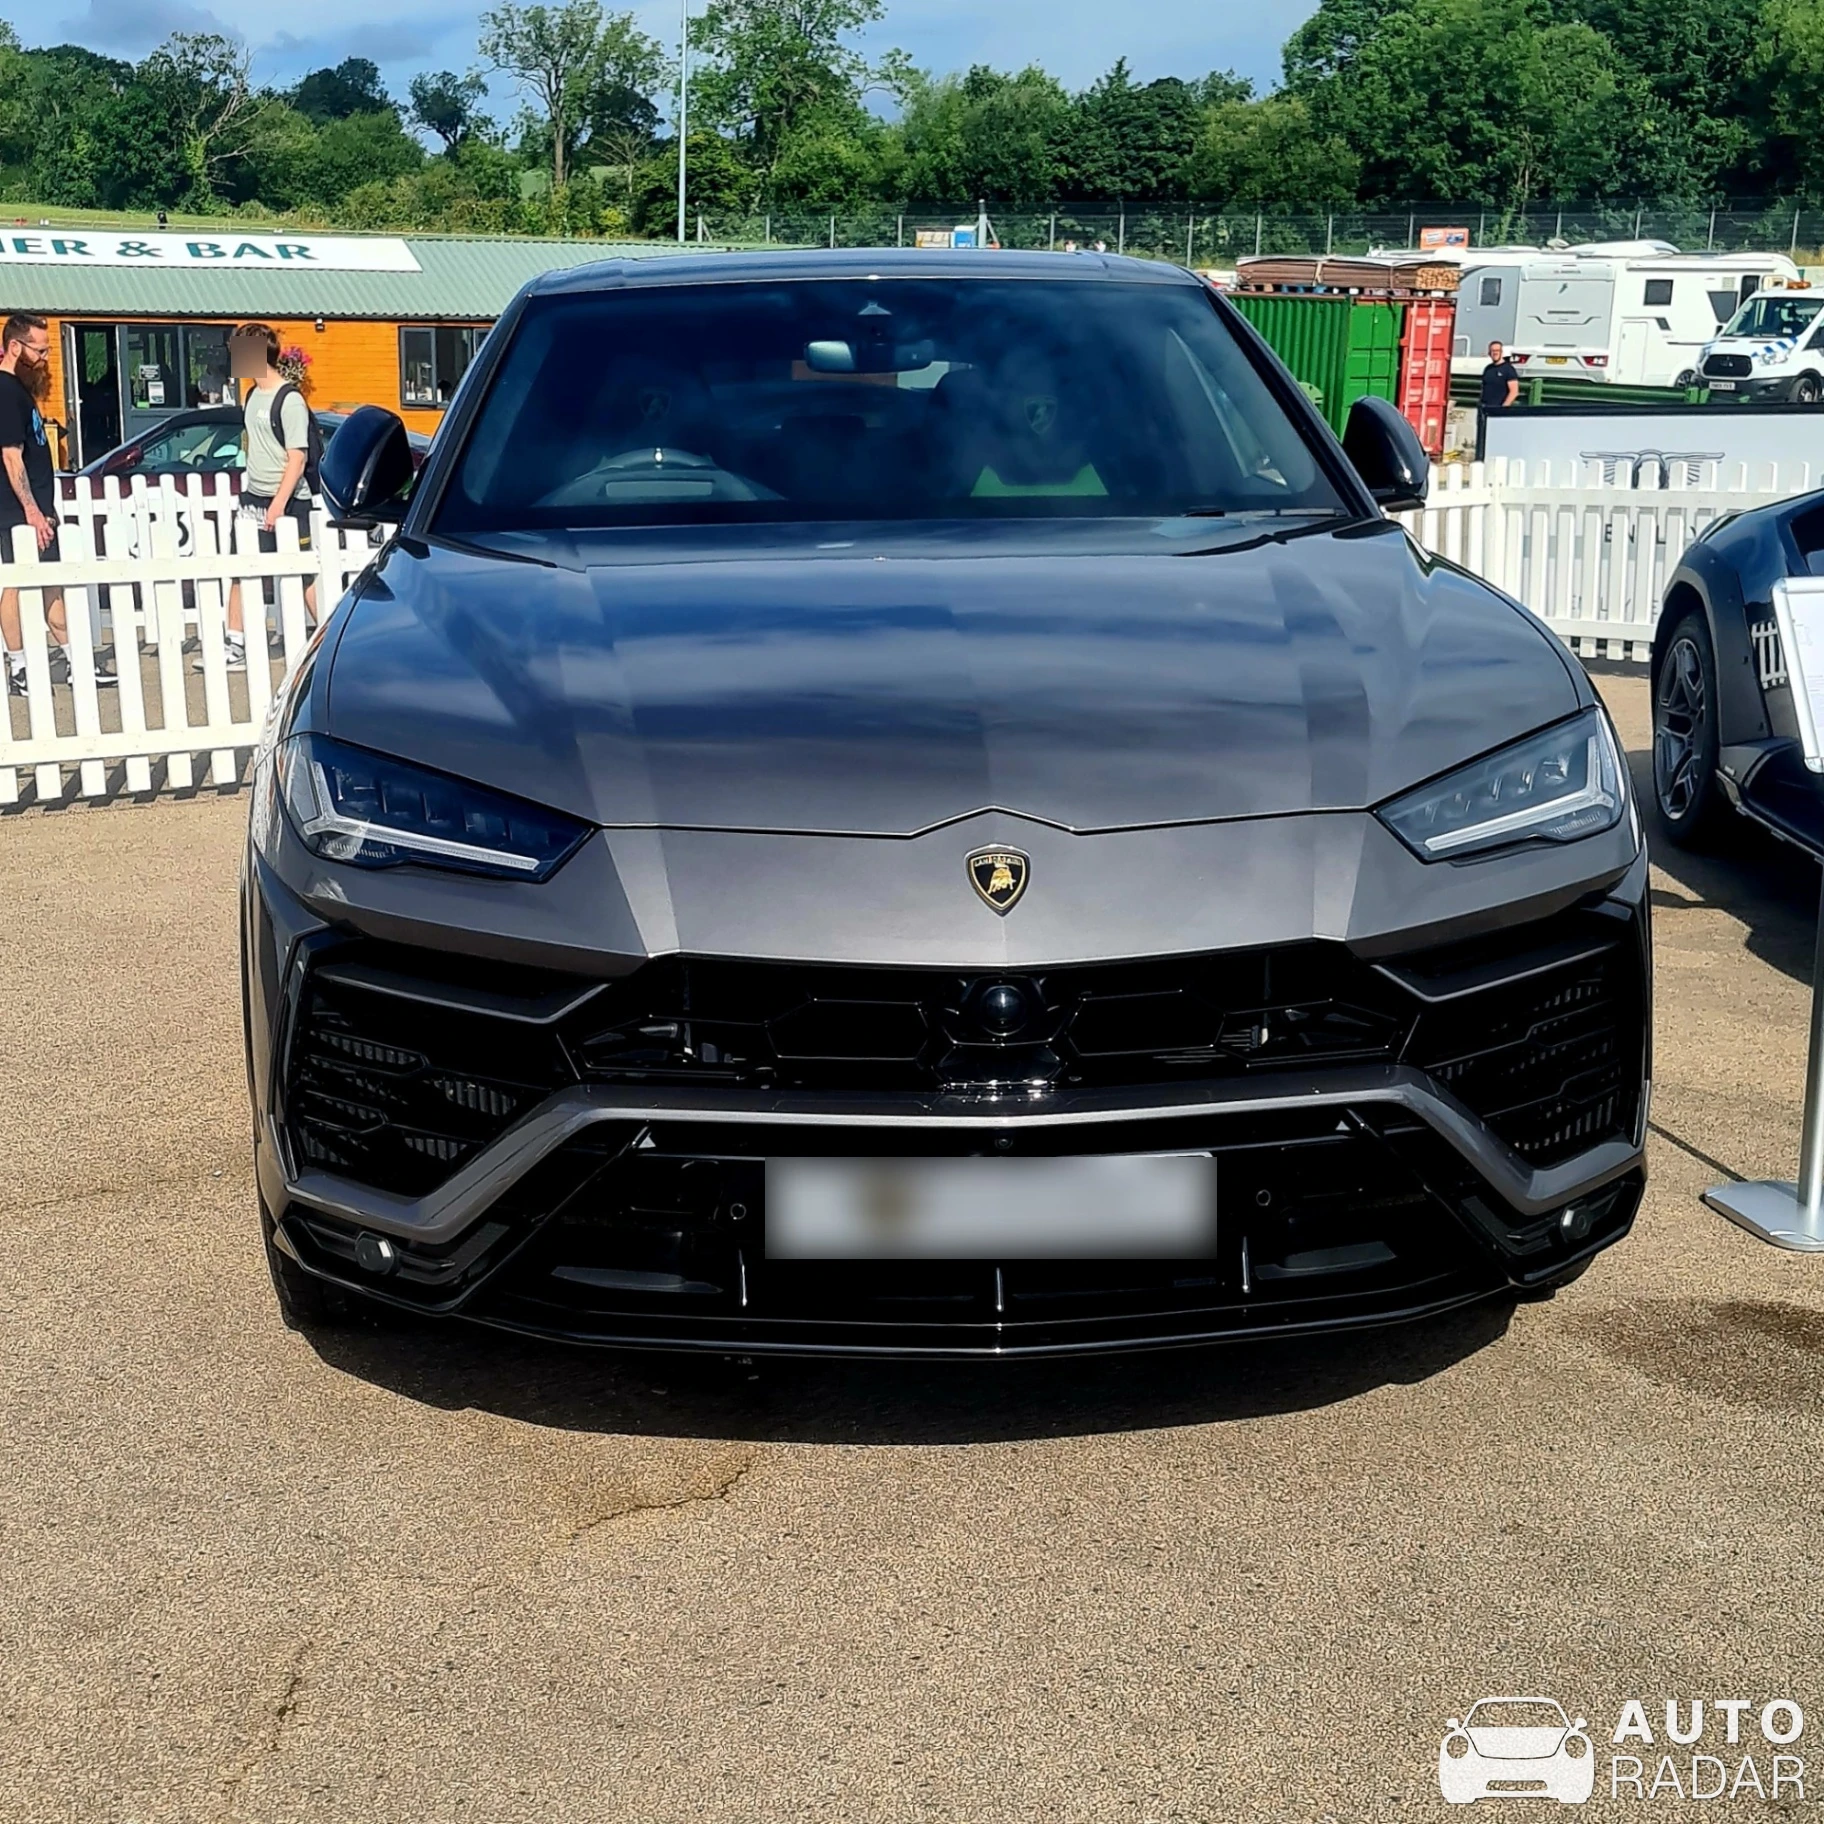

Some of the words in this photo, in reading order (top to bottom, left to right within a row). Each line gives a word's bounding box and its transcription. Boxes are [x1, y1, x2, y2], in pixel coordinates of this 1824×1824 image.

[0, 237, 95, 256] ER
[116, 241, 164, 258] &
[186, 242, 319, 260] BAR
